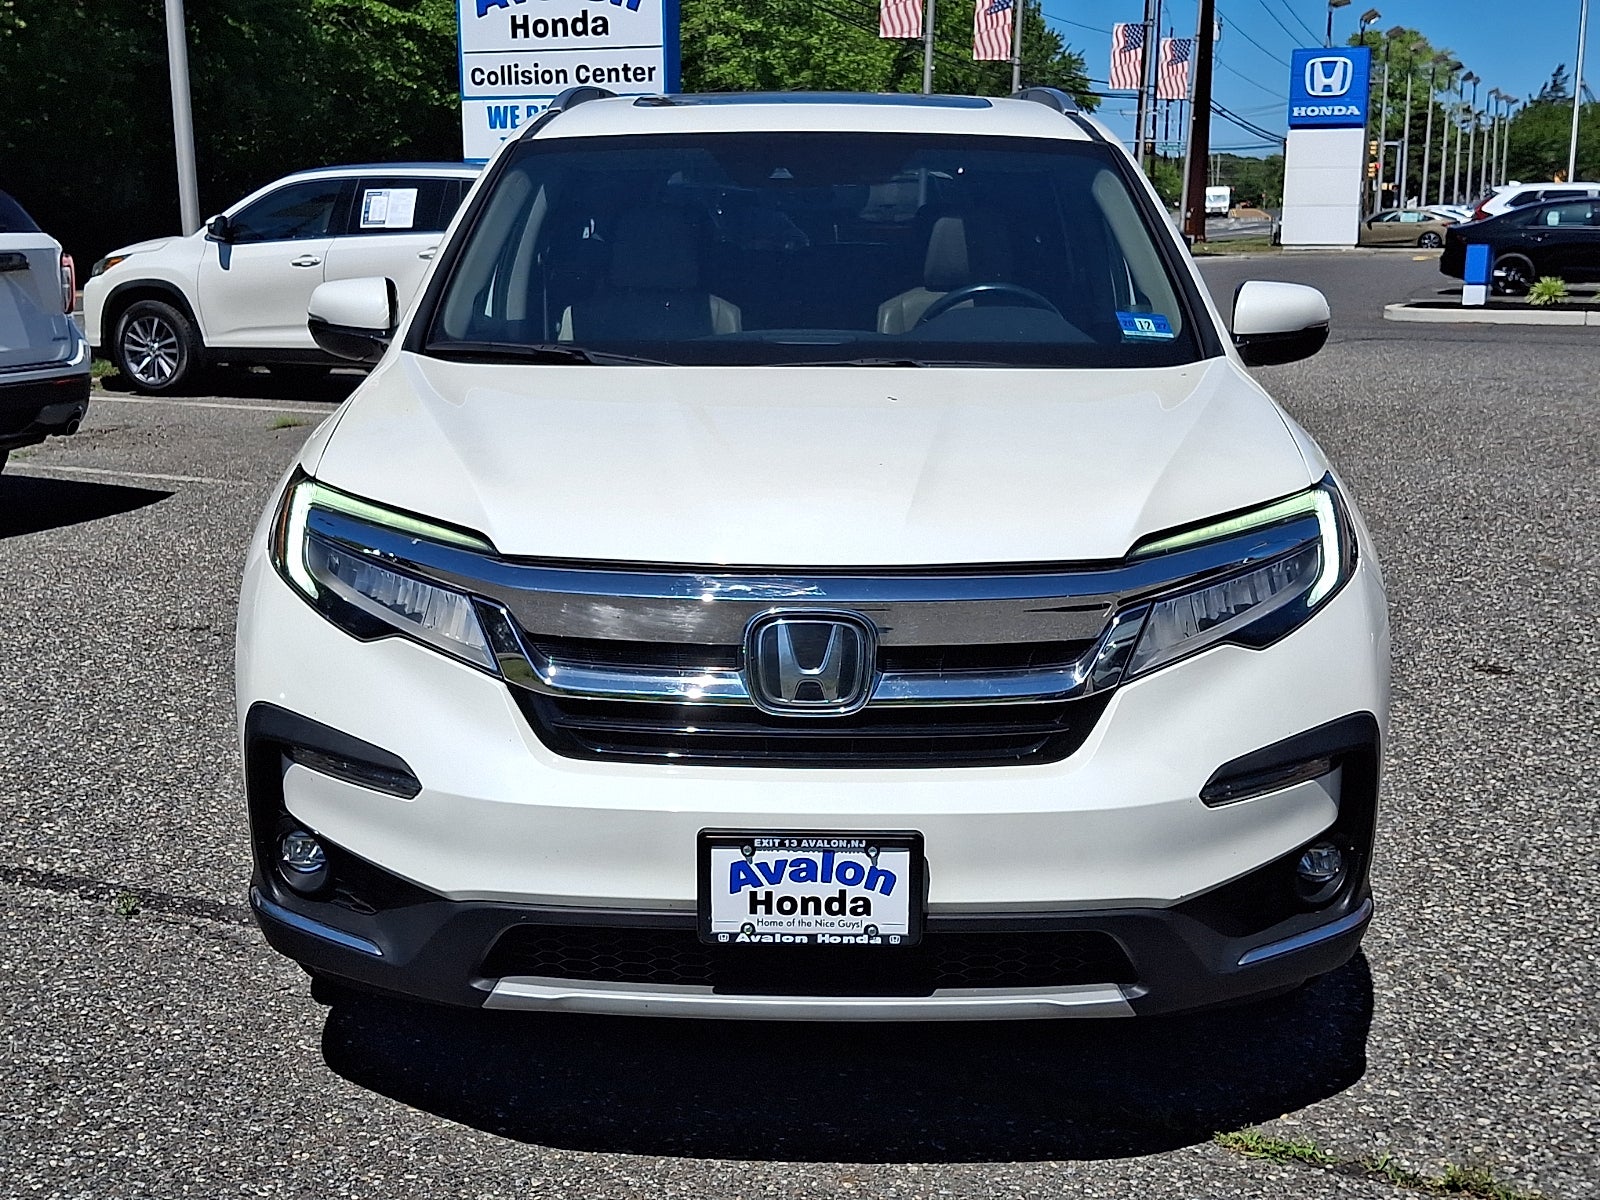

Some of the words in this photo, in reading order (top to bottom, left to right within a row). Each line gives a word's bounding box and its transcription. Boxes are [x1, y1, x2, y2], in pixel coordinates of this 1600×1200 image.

[511, 9, 610, 39] Honda
[470, 63, 568, 86] Collision
[575, 63, 656, 84] Center
[487, 105, 520, 129] WE
[1292, 105, 1360, 117] HONDA
[1138, 320, 1153, 331] 12
[754, 839, 781, 847] EXIT
[784, 839, 798, 847] 13
[729, 849, 897, 896] Avalon
[748, 889, 872, 916] Honda
[756, 918, 783, 927] Home
[786, 918, 796, 927] of
[798, 918, 812, 927] the
[815, 919, 835, 928] Nice
[838, 919, 863, 930] Guys!
[735, 933, 808, 943] Avalon
[817, 933, 882, 944] Honda
